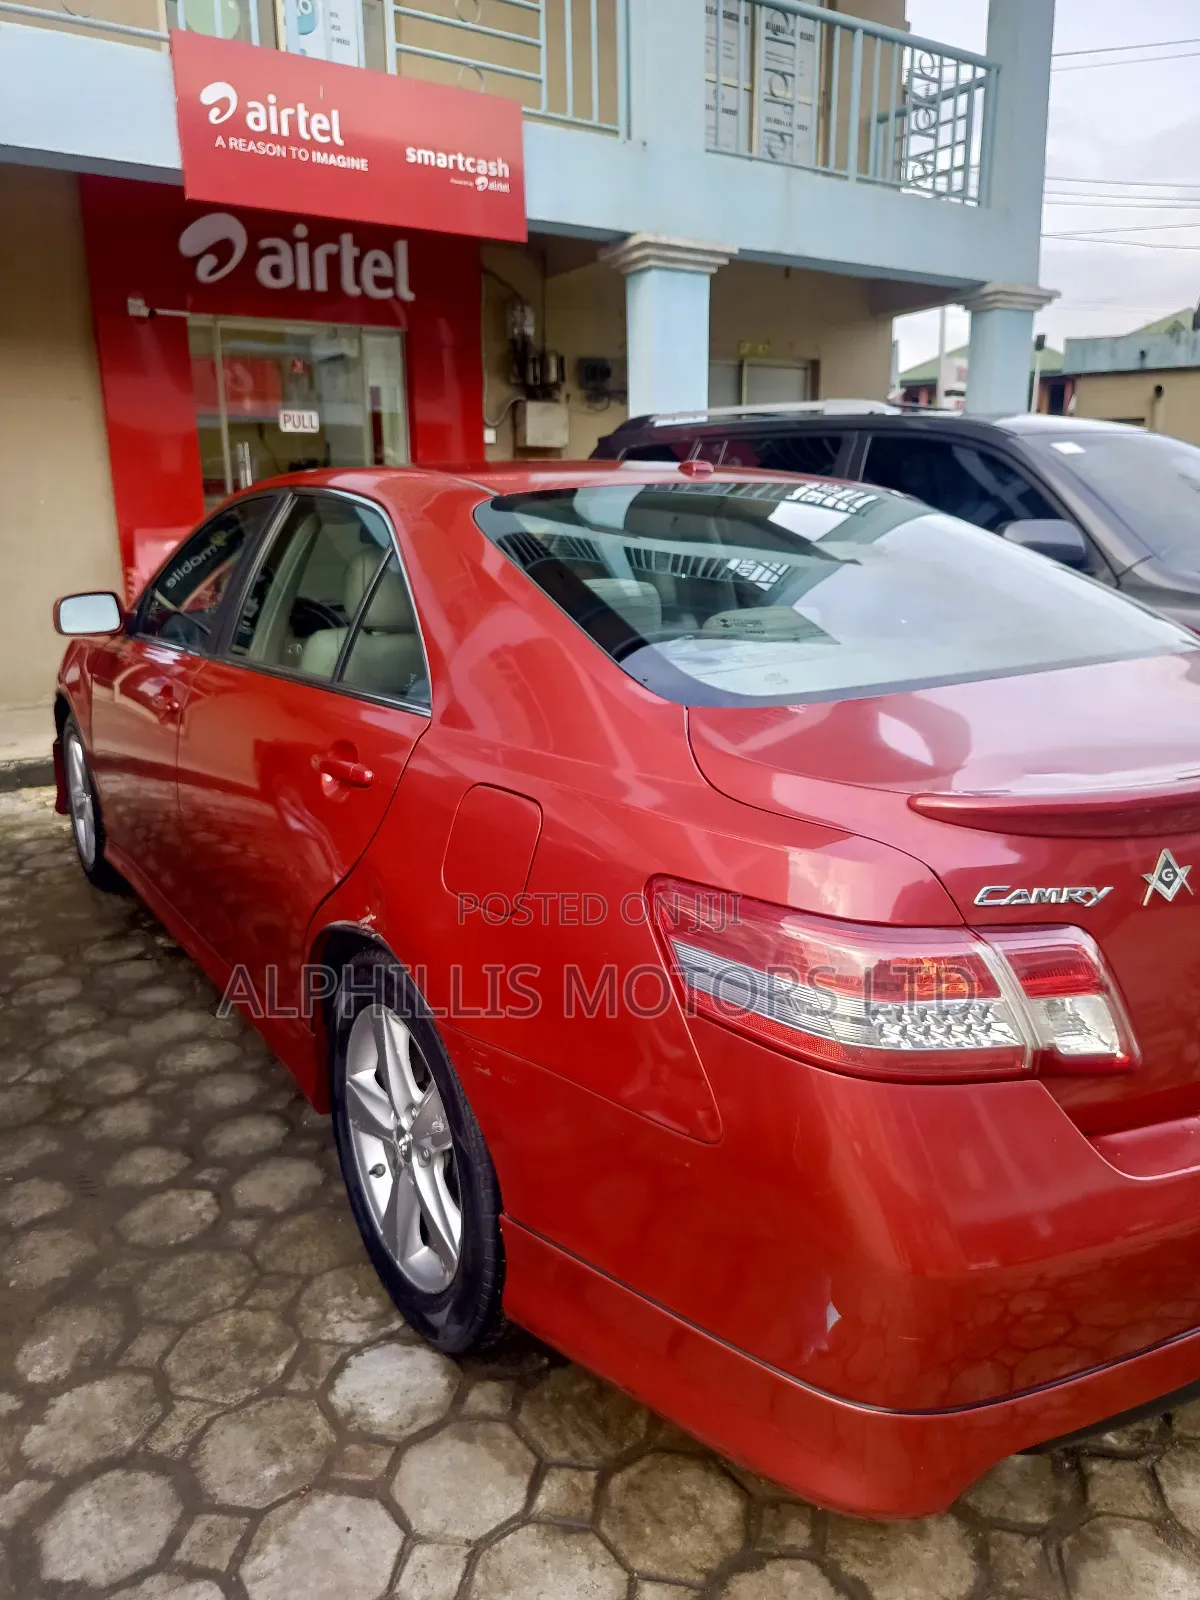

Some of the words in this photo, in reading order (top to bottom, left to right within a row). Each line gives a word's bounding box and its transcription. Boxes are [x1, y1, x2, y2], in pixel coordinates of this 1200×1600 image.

[245, 93, 345, 147] airtel
[214, 135, 227, 149] A
[228, 136, 287, 158] REASON
[288, 146, 310, 162] TO
[311, 150, 369, 172] IMAGINE
[405, 146, 510, 179] smartcash
[255, 223, 416, 302] airtel
[283, 413, 317, 430] PULL
[1161, 867, 1174, 882] G
